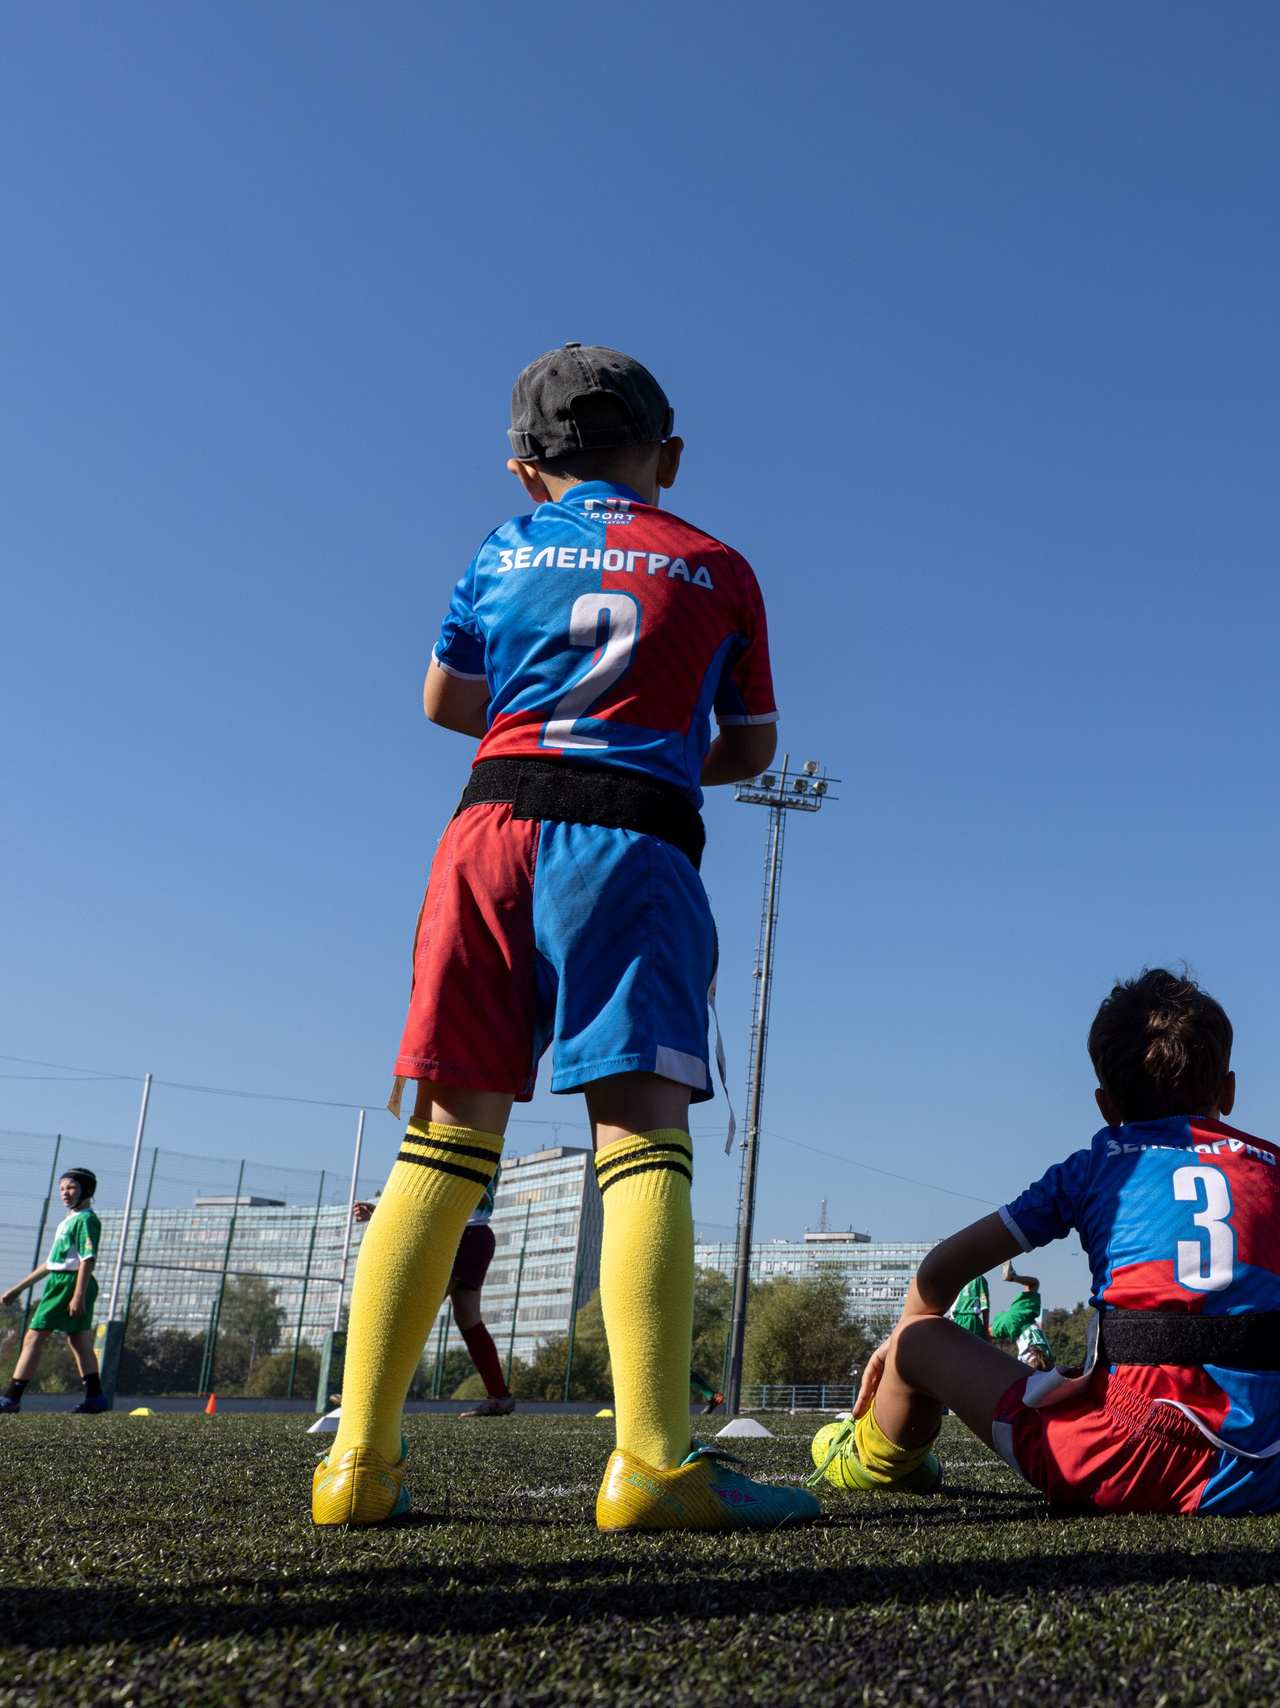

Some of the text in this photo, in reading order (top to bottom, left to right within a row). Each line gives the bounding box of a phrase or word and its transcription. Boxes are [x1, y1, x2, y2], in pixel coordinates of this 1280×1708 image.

[497, 547, 714, 590] ЗЕЛЕНОГРАД
[542, 592, 639, 749] 2
[1172, 1166, 1235, 1292] 3
